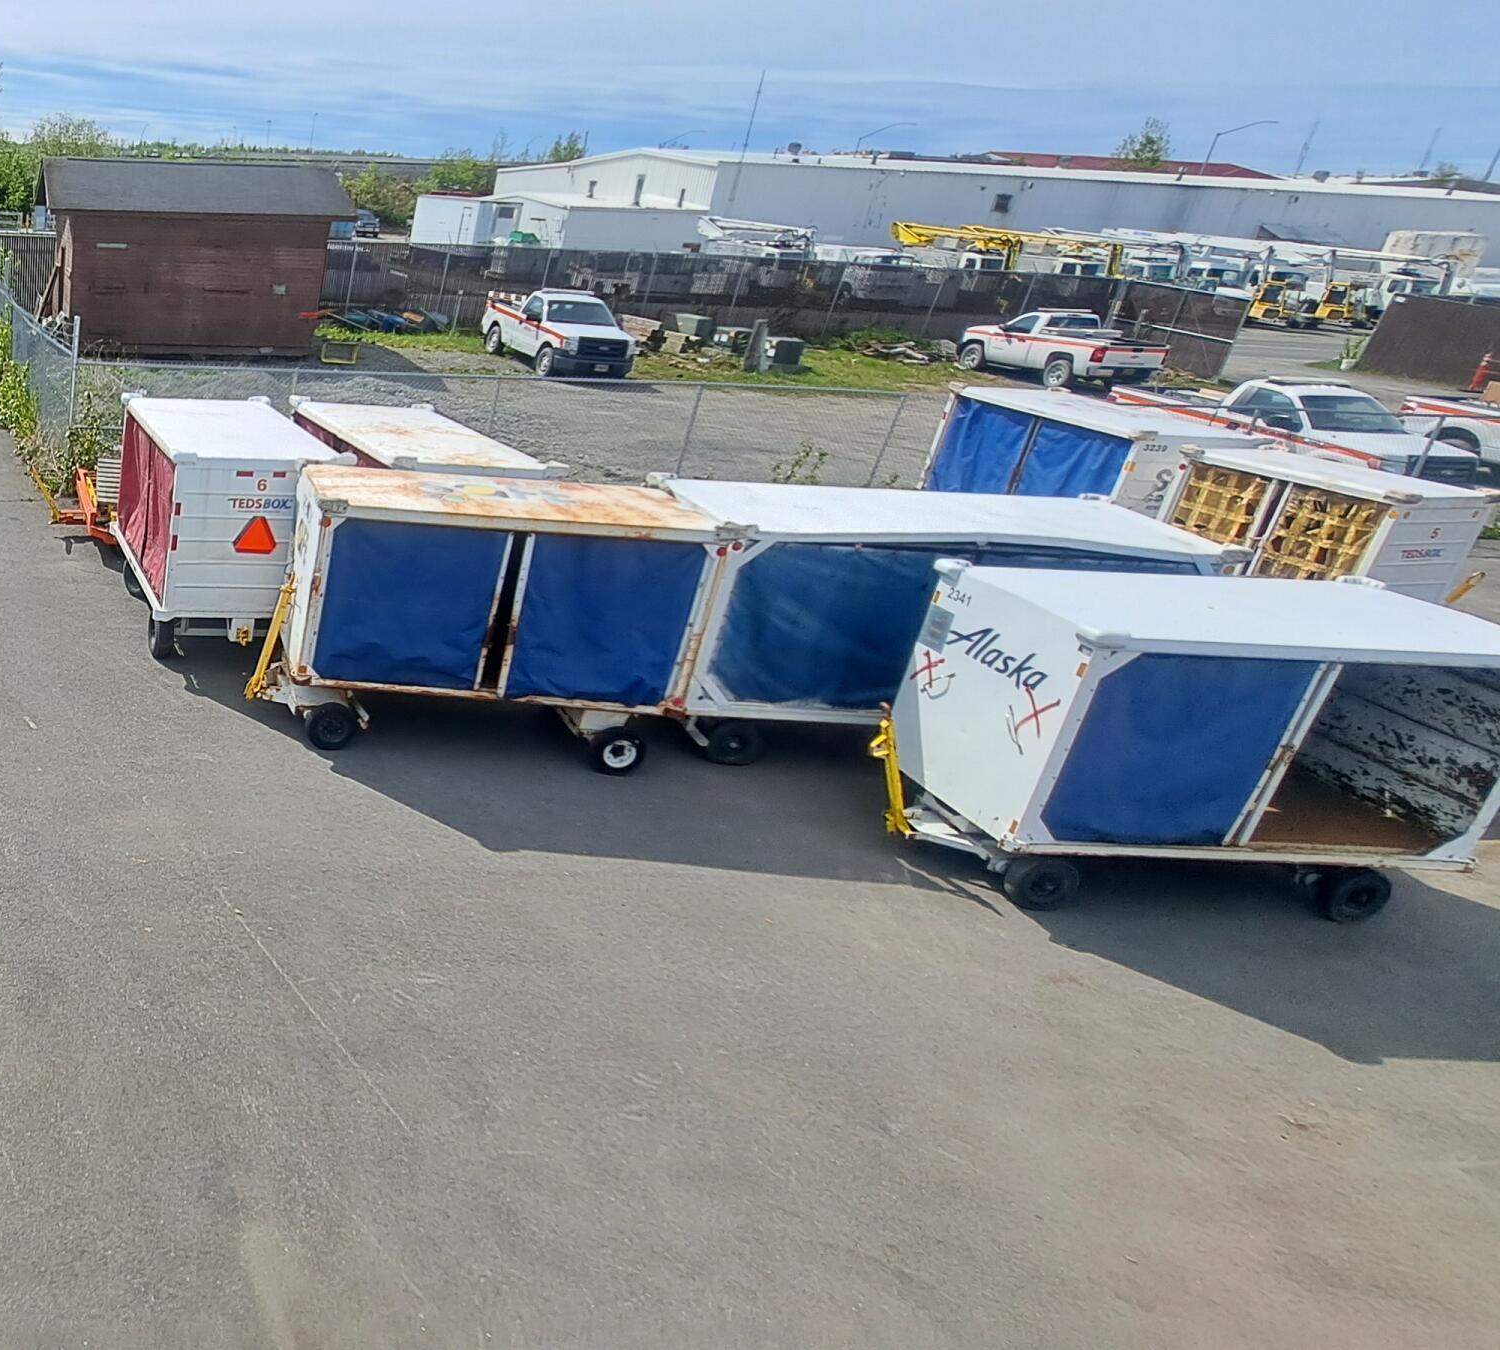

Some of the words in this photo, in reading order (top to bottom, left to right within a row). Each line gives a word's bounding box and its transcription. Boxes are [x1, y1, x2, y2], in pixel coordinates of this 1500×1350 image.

[1143, 444, 1169, 453] 3239
[257, 479, 268, 492] 6
[228, 498, 293, 510] TEDSBOX
[1430, 527, 1442, 539] 5
[947, 587, 972, 607] 2341
[945, 627, 1049, 692] Alaska
